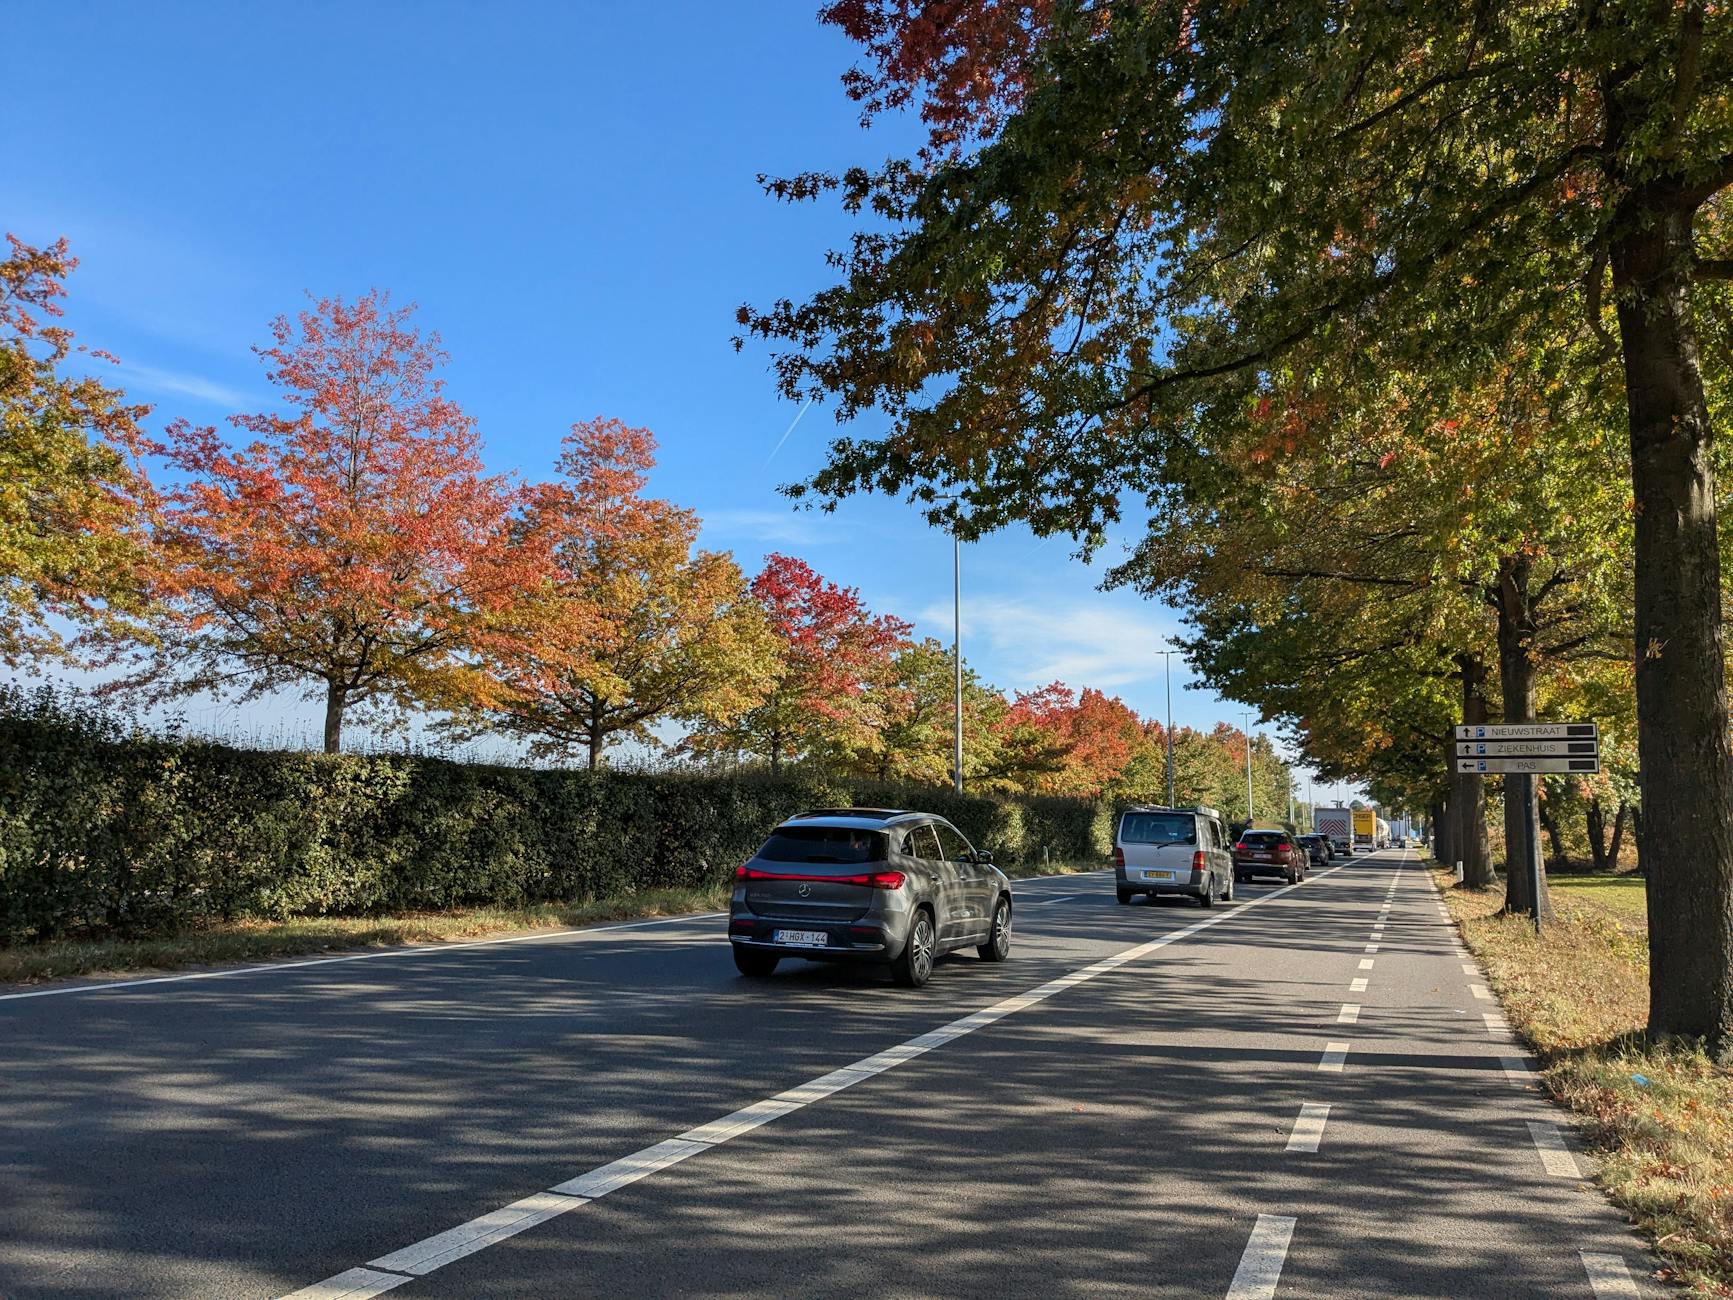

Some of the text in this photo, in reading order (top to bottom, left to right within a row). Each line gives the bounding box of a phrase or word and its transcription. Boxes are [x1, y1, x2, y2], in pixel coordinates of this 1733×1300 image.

[1491, 727, 1560, 736] NIEUWSTRAAT
[1497, 744, 1556, 753] ZIEKENHUIS
[1517, 762, 1537, 770] PAS
